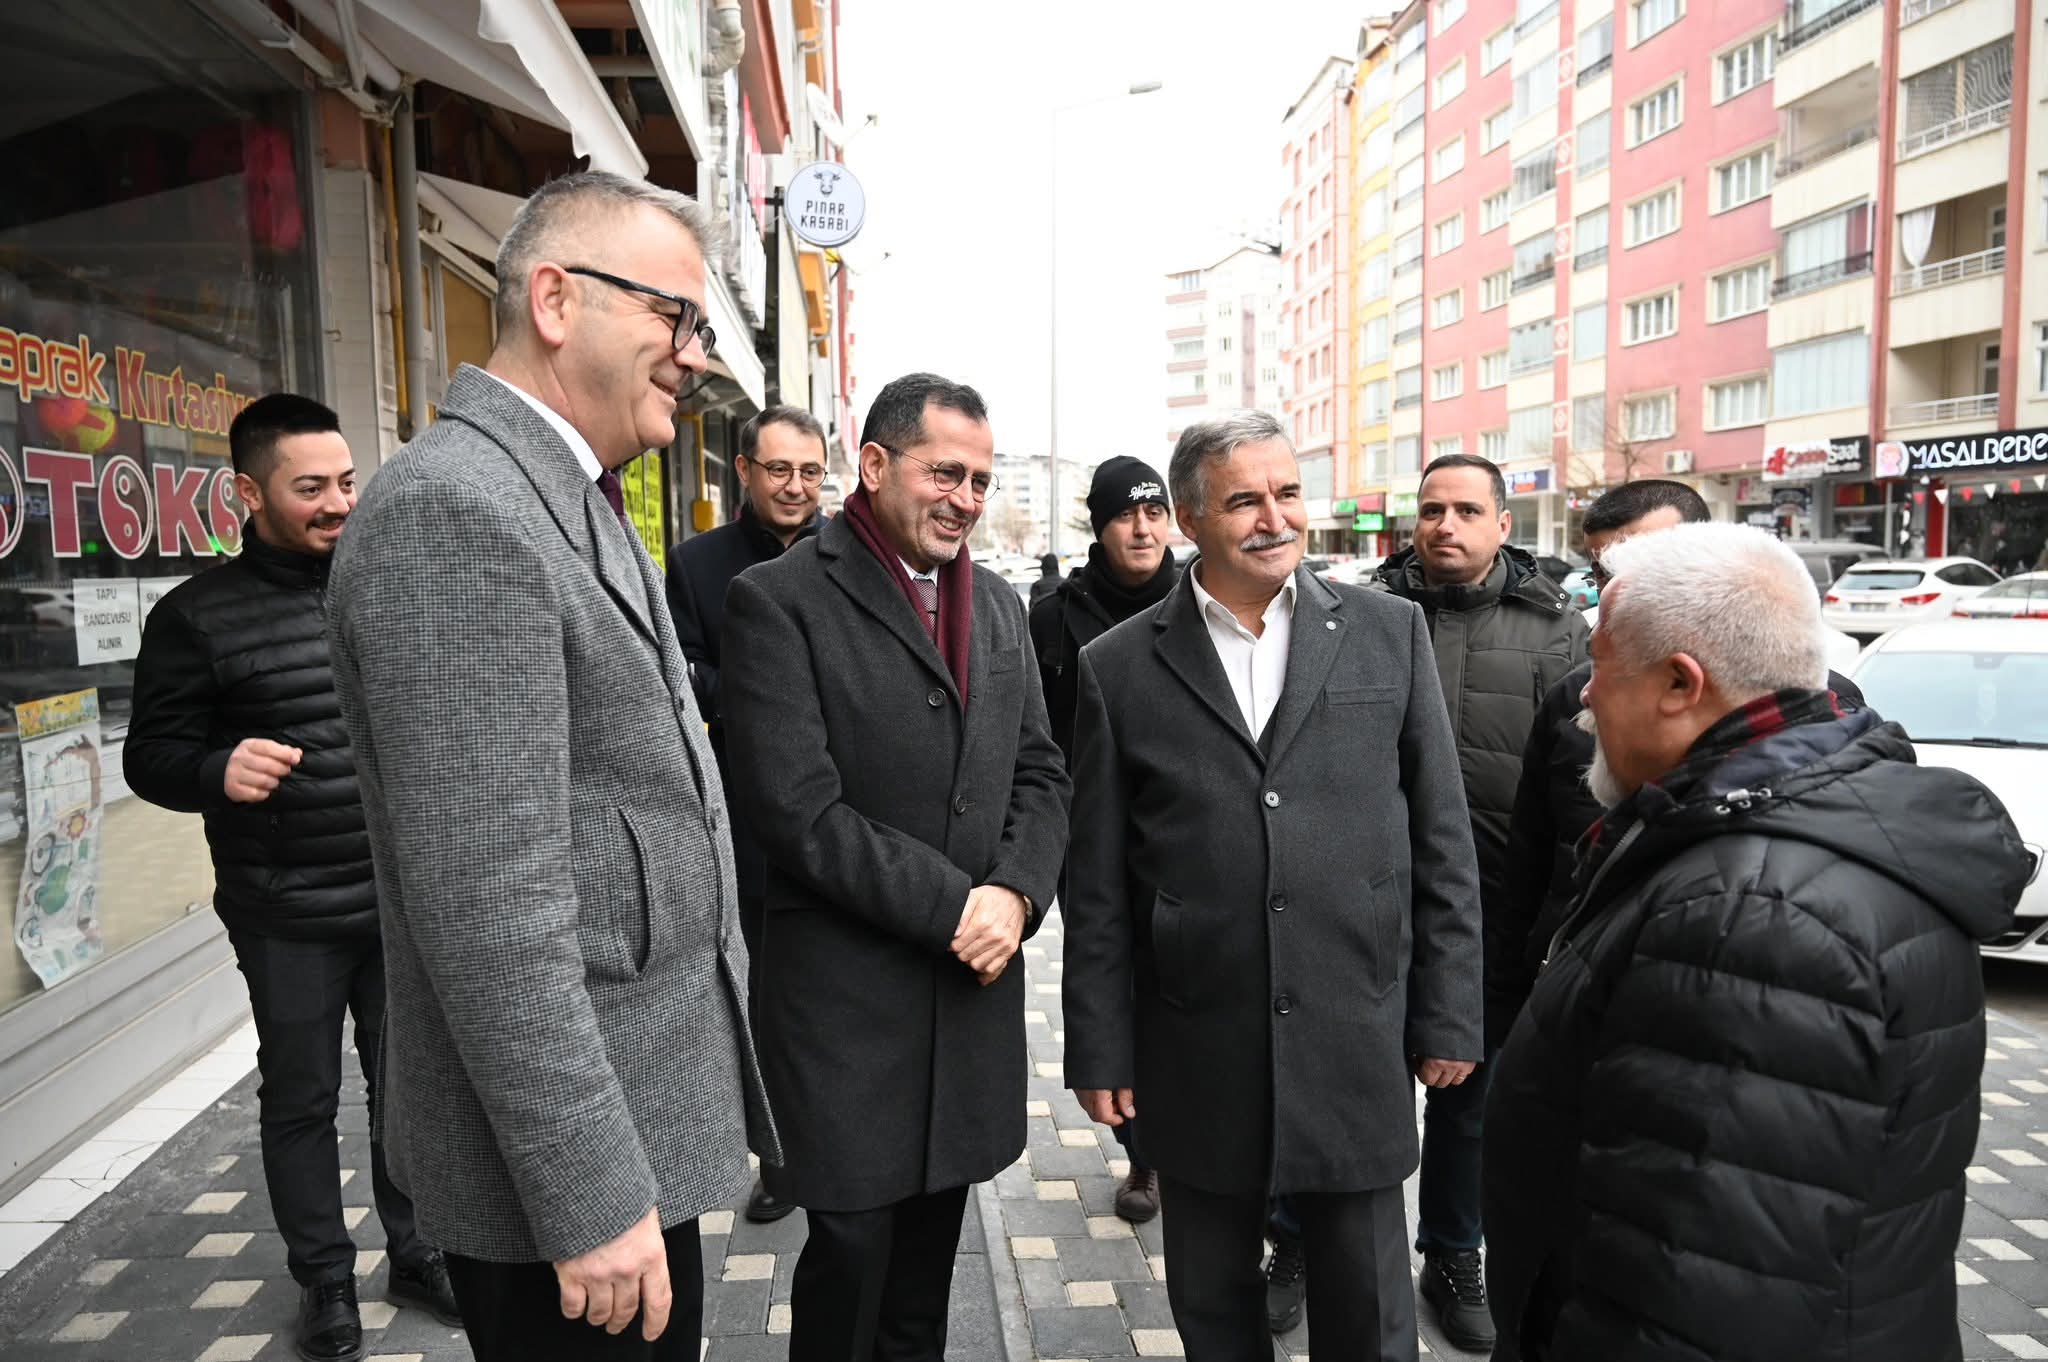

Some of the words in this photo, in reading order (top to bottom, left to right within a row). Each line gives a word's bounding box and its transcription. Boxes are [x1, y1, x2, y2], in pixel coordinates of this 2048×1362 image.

[806, 200, 845, 216] PINAR
[800, 215, 849, 231] KASABI
[96, 588, 117, 600] TAPU
[97, 636, 122, 650] ALINIR
